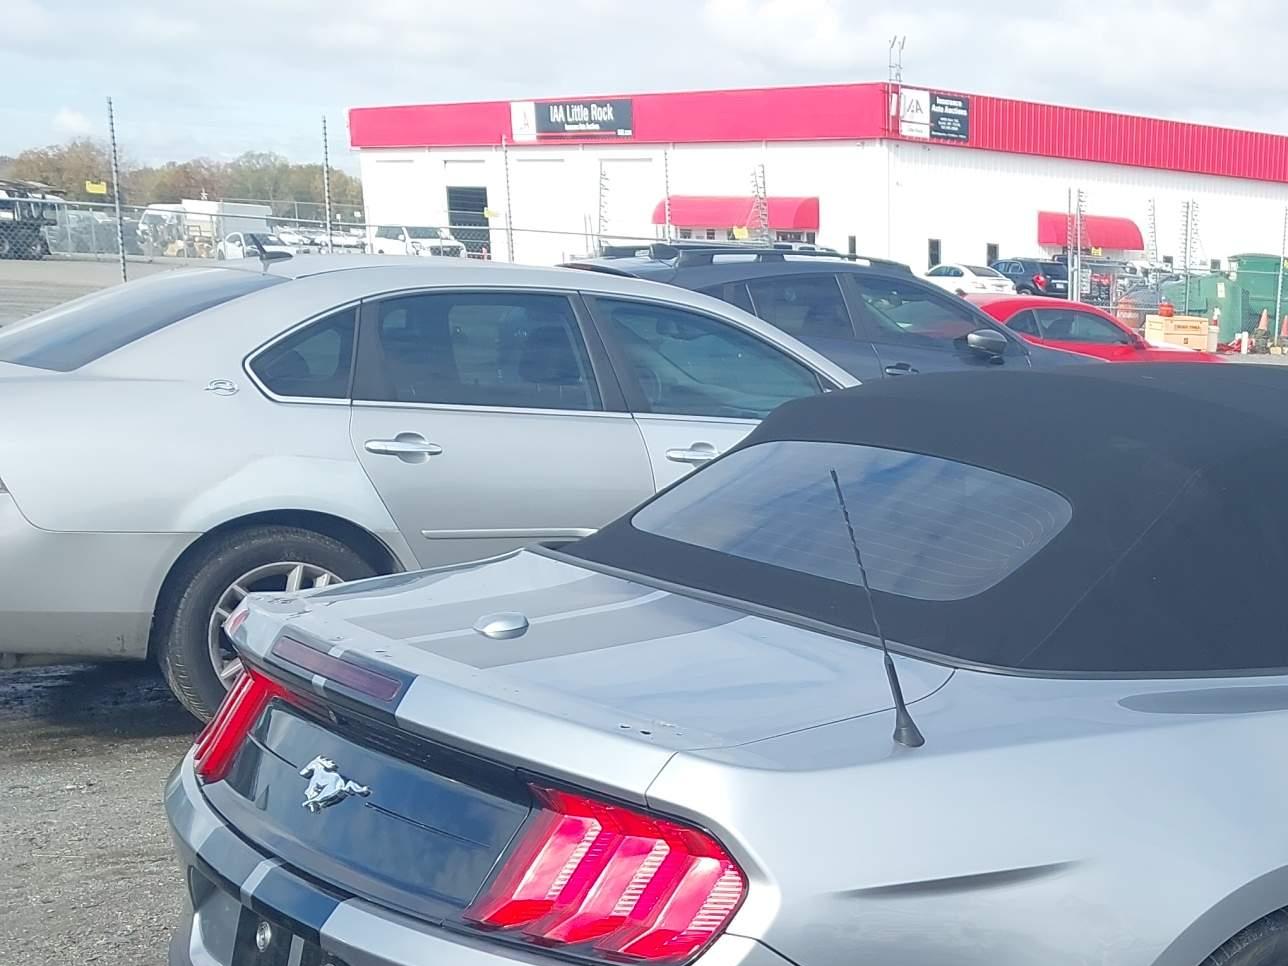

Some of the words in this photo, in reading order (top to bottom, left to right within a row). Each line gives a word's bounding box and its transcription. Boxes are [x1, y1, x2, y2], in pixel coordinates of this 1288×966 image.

[549, 105, 565, 122] IAA
[566, 104, 589, 122] Little
[590, 103, 614, 121] Rock
